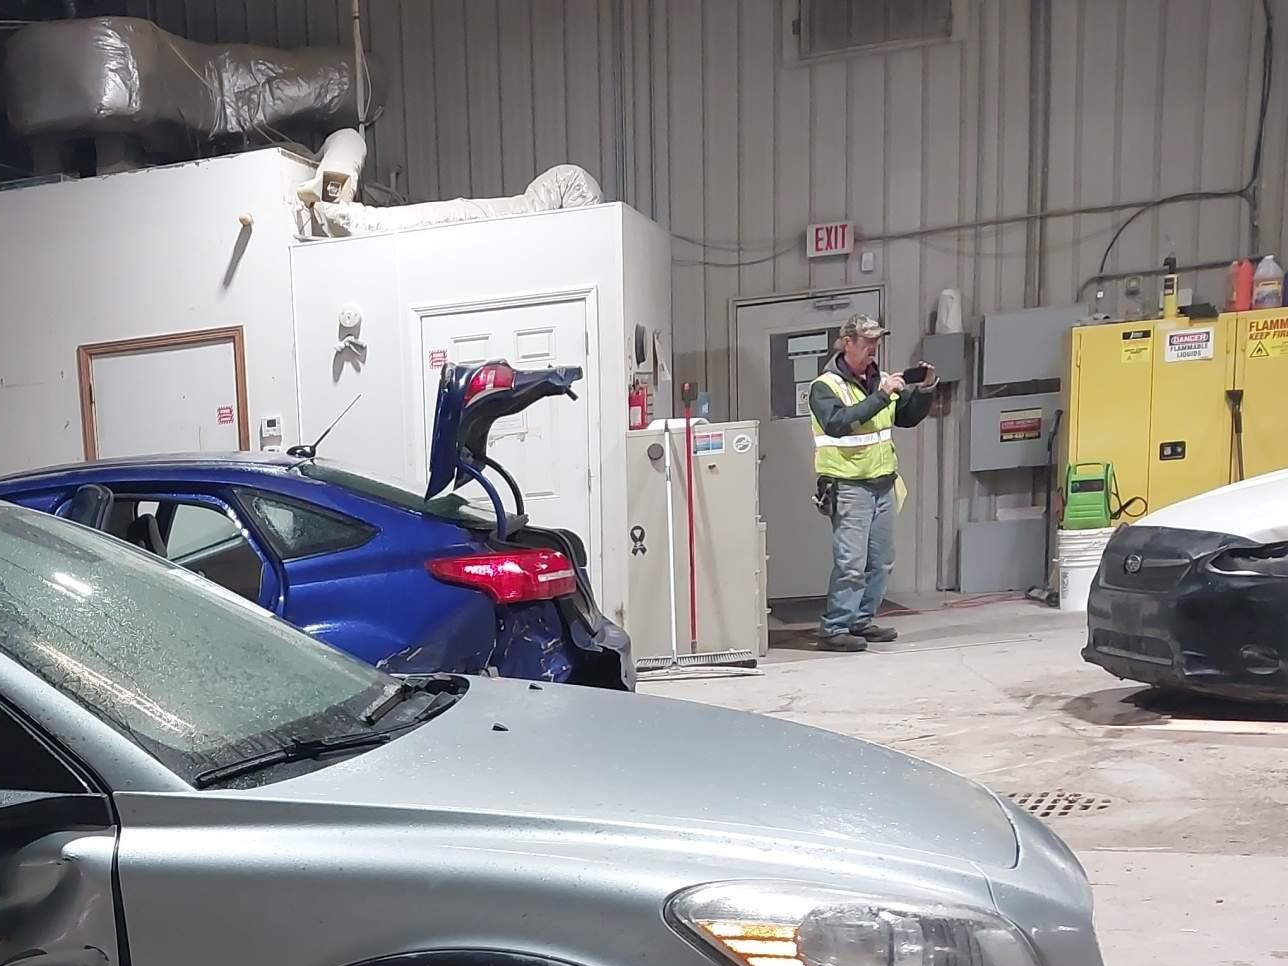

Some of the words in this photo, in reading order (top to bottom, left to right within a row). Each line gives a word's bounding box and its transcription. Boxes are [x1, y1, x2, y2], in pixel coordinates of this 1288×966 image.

[815, 224, 848, 252] EXIT
[1173, 334, 1207, 344] DANGER
[1249, 331, 1271, 340] KEEP
[1170, 343, 1208, 352] FLAMMABLE
[1177, 350, 1202, 358] LIQUIDS
